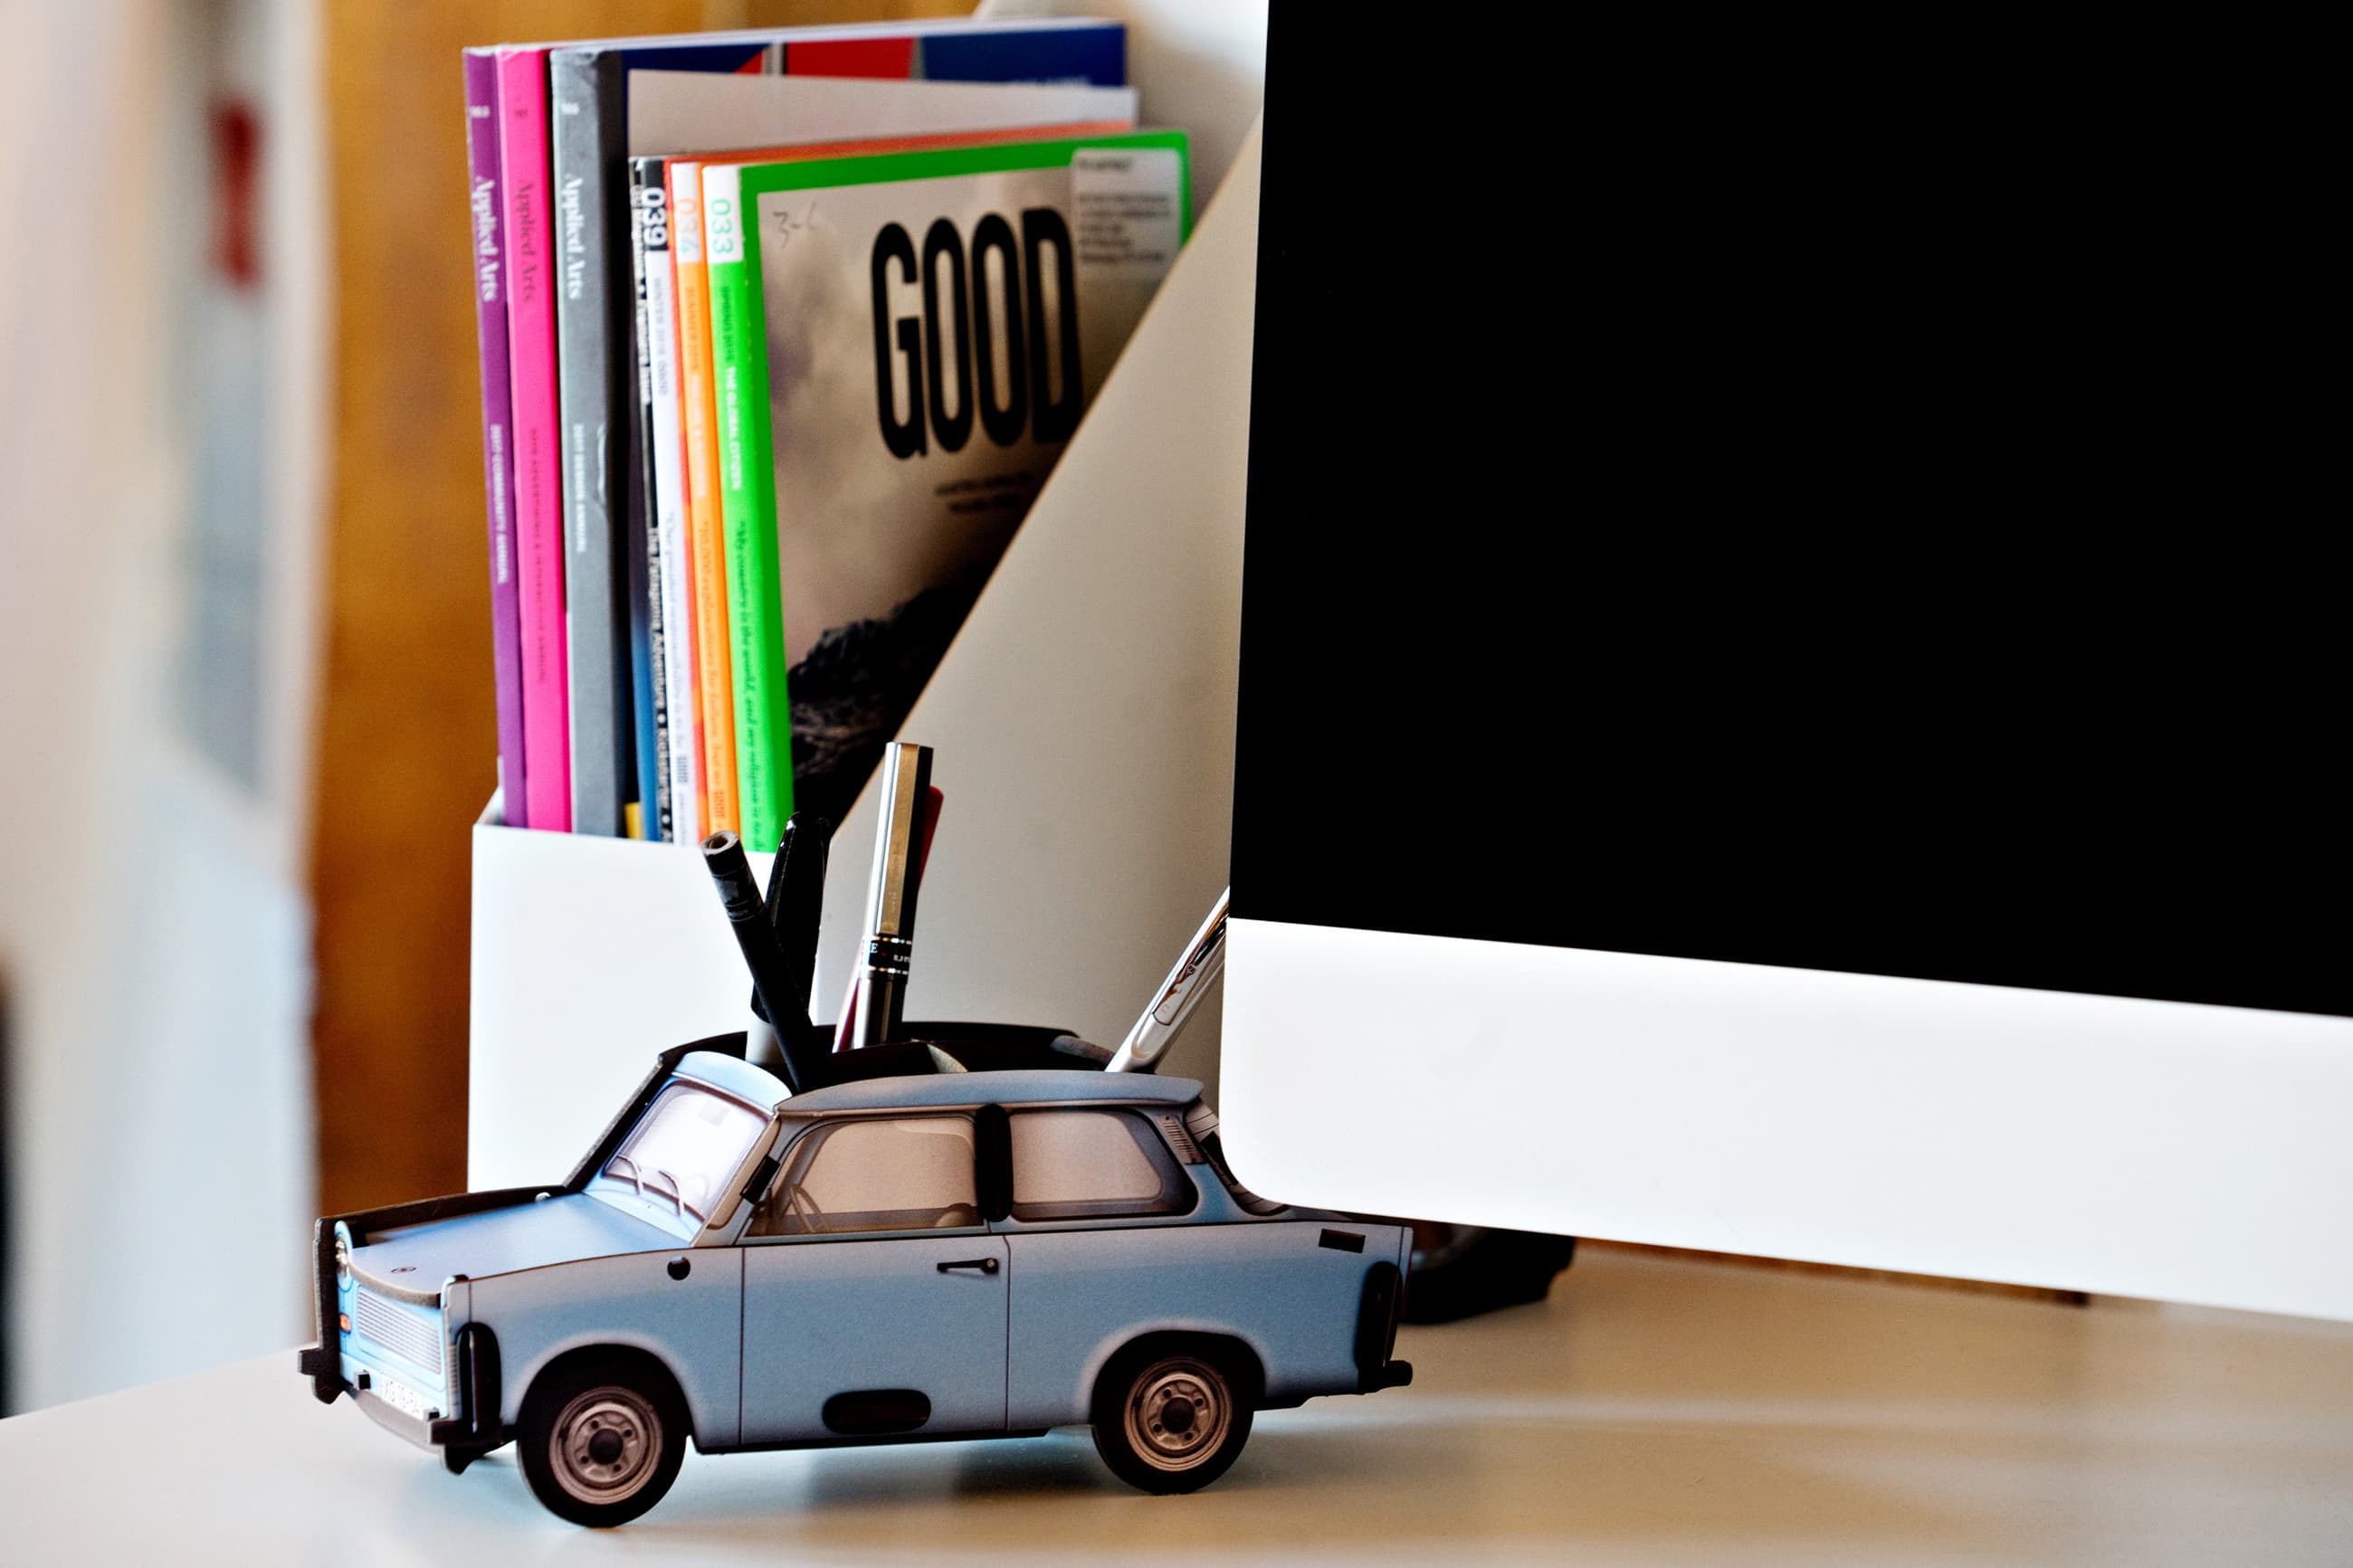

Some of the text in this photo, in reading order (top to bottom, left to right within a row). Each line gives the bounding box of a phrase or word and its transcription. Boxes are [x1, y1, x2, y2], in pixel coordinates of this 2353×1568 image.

[472, 176, 499, 302] Applied Arts
[516, 179, 537, 302] Applied Arts
[561, 174, 585, 300] Applied Arts
[643, 186, 667, 245] 039
[674, 197, 700, 256] 034
[710, 197, 734, 255] 033
[871, 207, 1091, 461] GOOD
[725, 366, 736, 389] THE
[727, 391, 738, 440] GLOBAL
[729, 441, 741, 489] CITIZEN
[495, 533, 508, 584] ANNUAL
